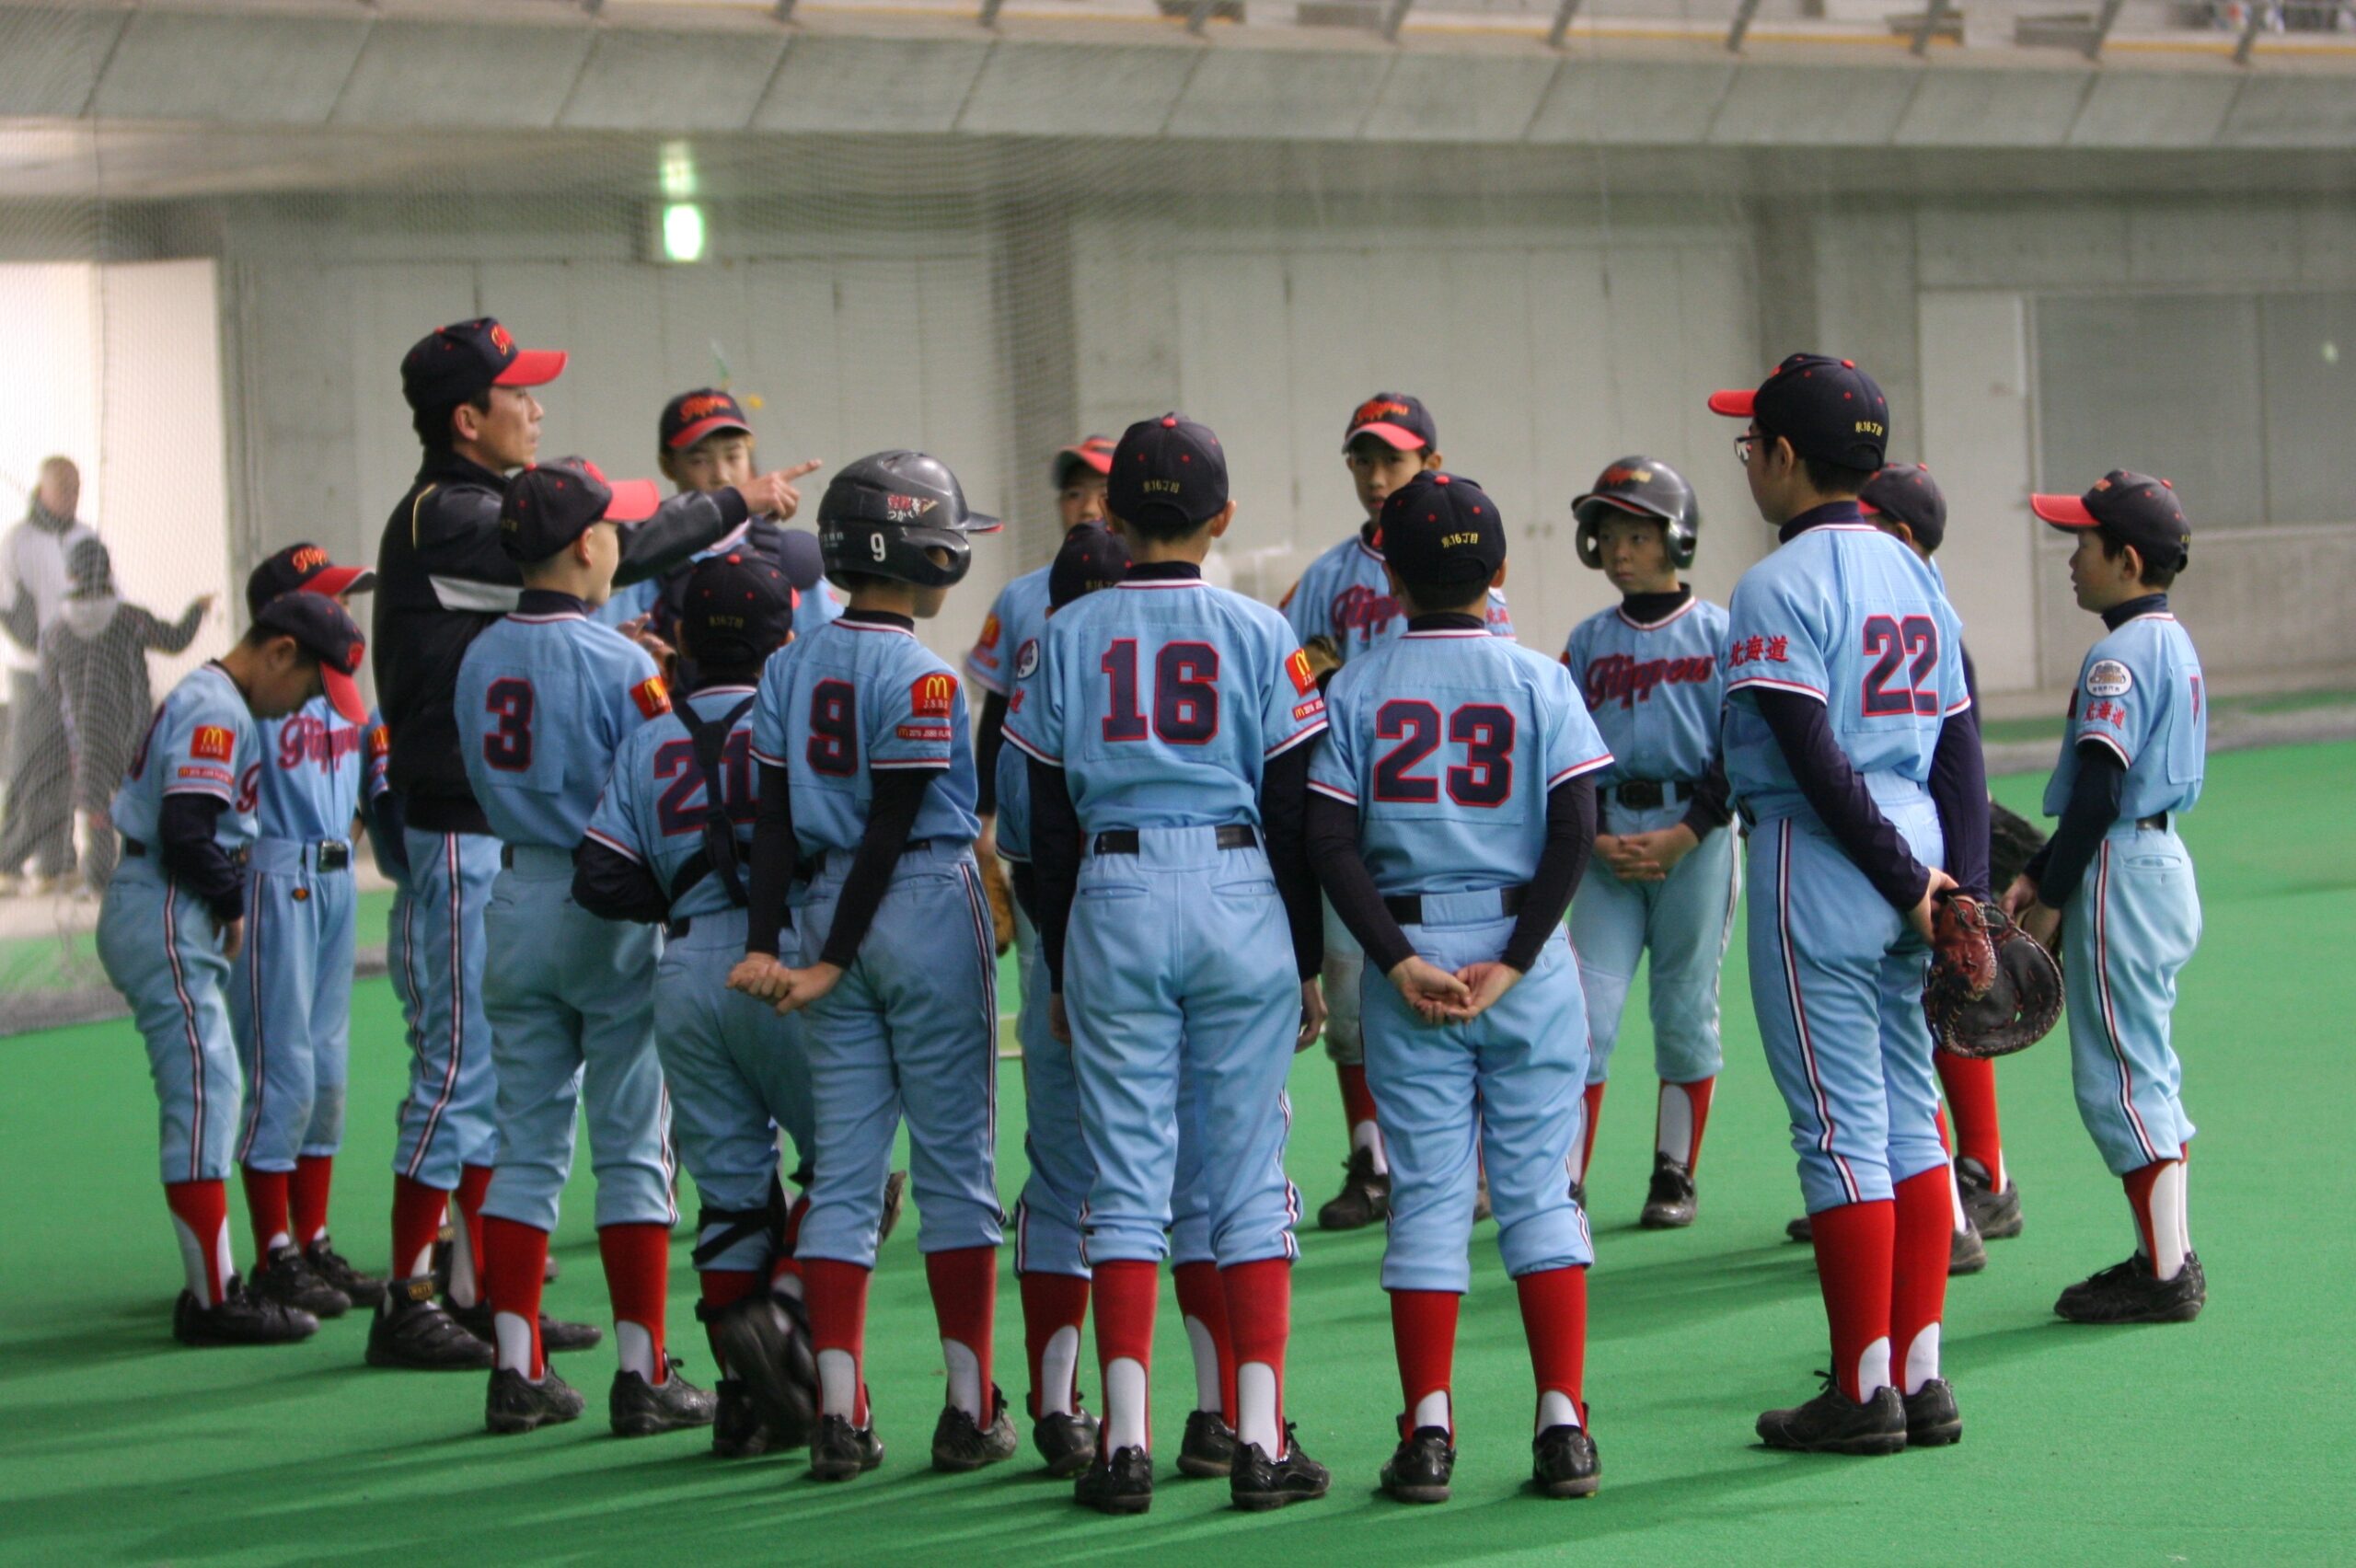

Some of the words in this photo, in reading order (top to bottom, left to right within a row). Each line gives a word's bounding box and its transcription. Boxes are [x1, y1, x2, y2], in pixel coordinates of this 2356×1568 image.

[870, 533, 886, 562] 9
[1102, 637, 1219, 746] 16
[1727, 634, 1789, 669] 北海道
[1862, 614, 1938, 718] 22
[483, 676, 534, 774] 3
[806, 677, 859, 778] 9
[1373, 698, 1517, 809] 23
[654, 730, 760, 837] 21
